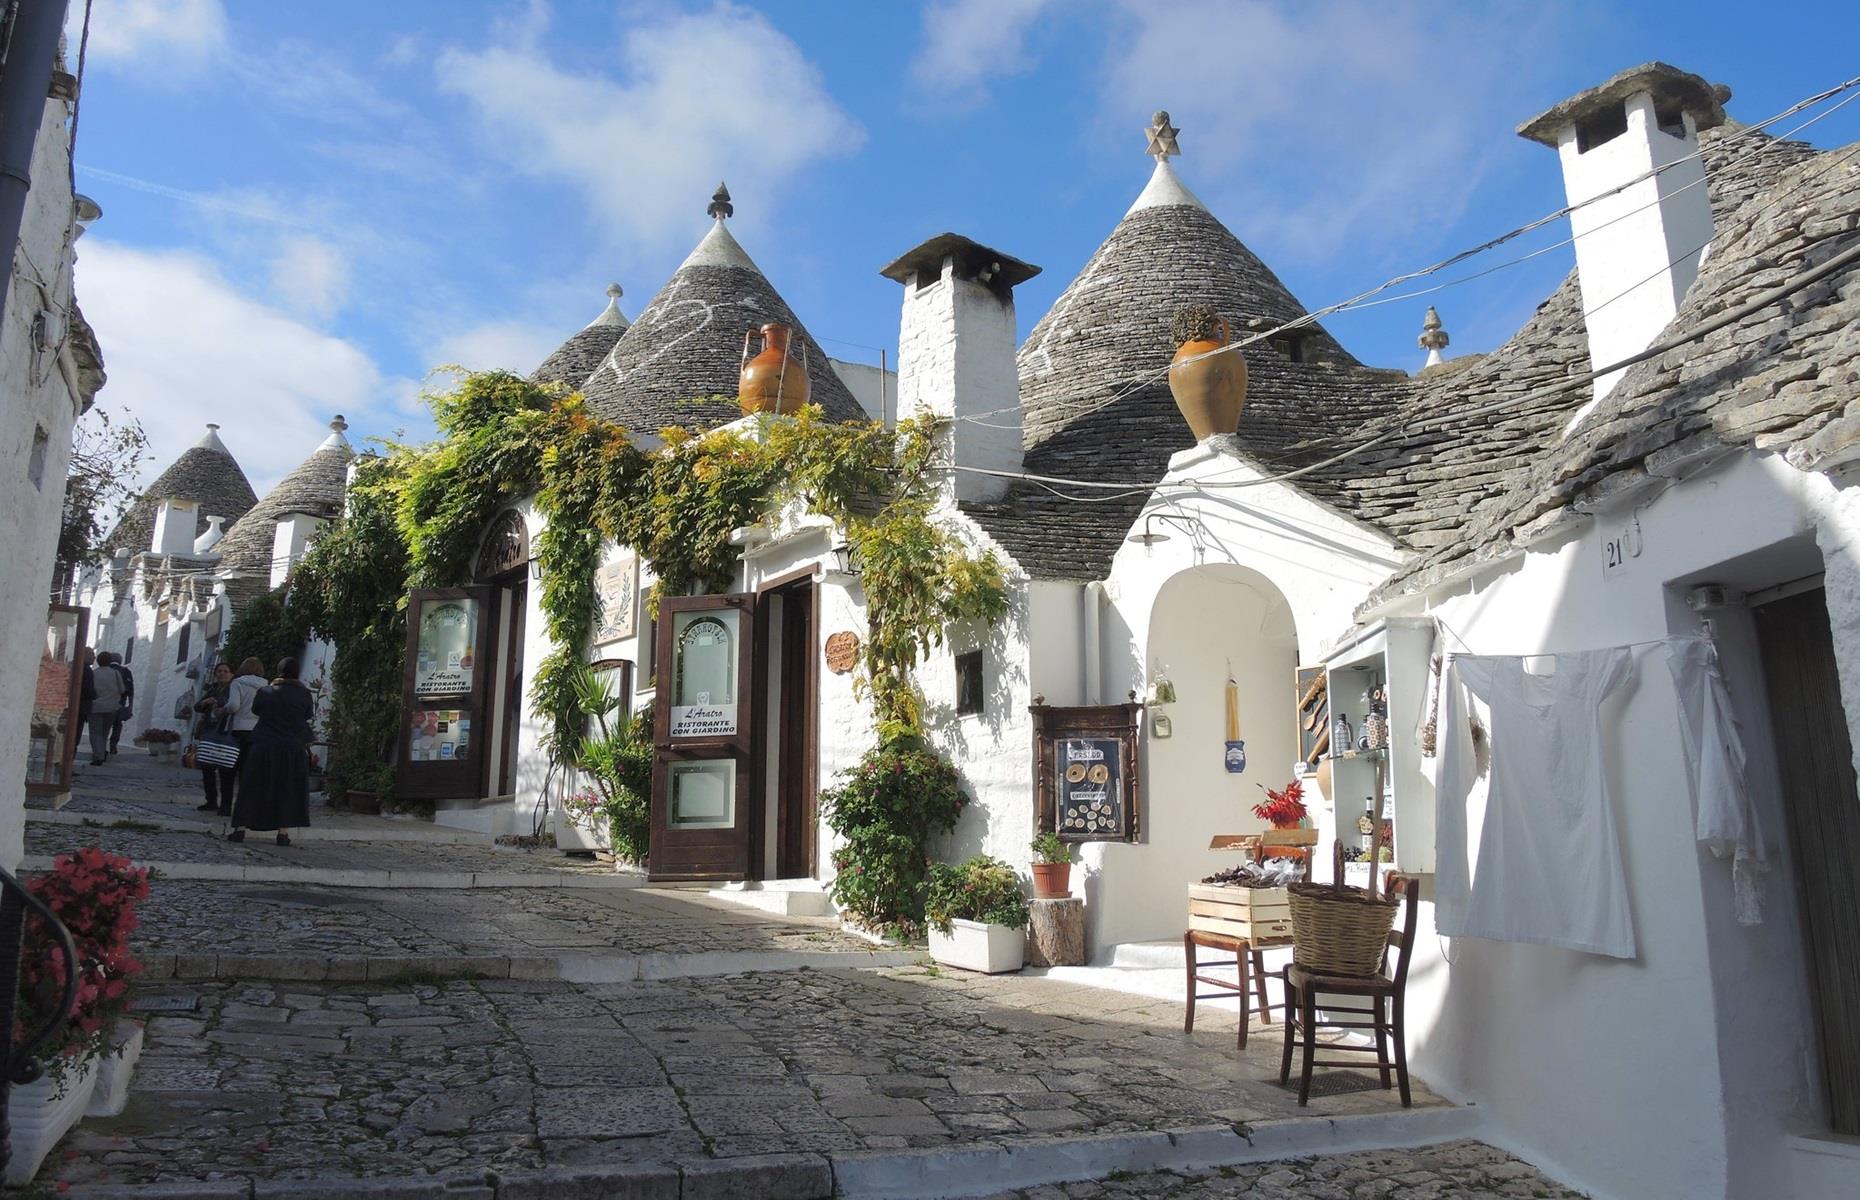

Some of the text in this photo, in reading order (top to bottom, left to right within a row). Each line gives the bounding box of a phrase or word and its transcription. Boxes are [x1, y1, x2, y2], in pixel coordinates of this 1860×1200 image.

[1607, 538, 1622, 568] 21
[428, 672, 461, 680] L'Aratro
[685, 708, 723, 719] L'Aratro
[677, 720, 730, 728] RISTORANTE
